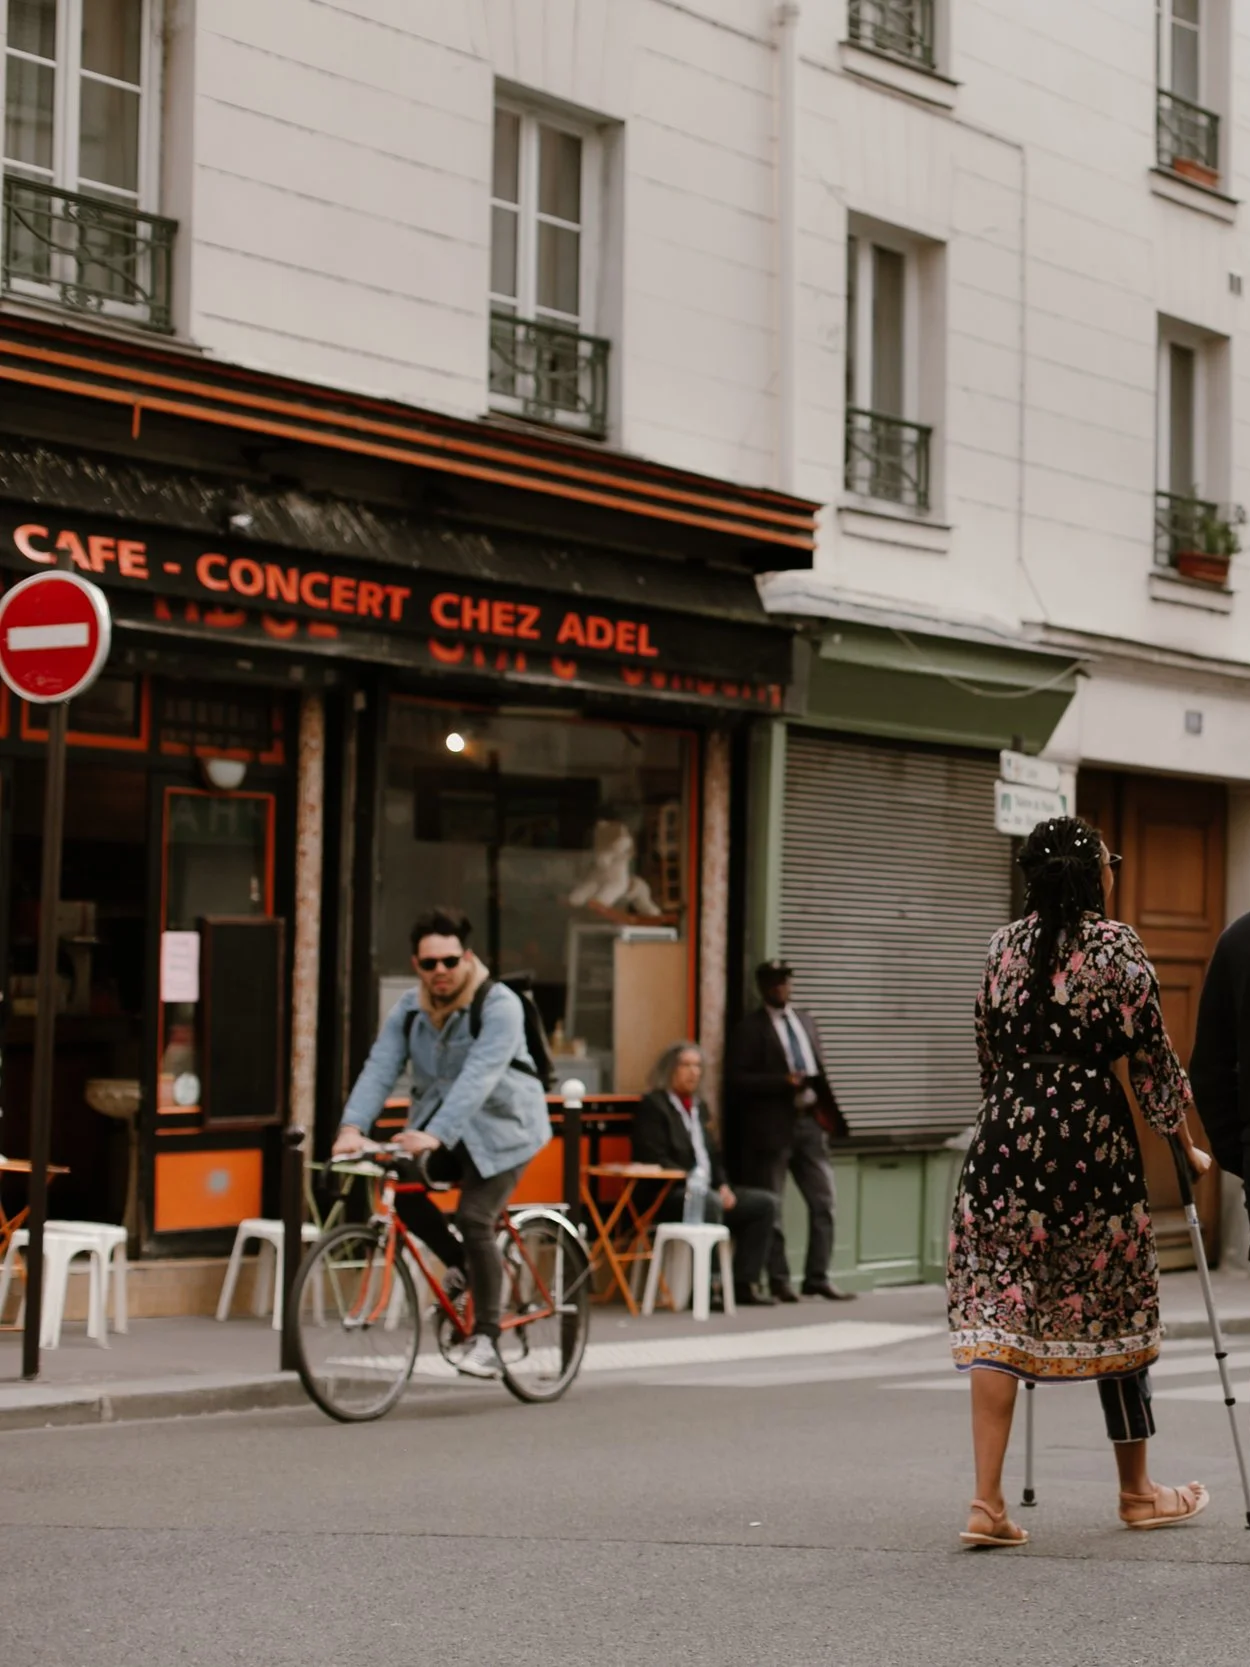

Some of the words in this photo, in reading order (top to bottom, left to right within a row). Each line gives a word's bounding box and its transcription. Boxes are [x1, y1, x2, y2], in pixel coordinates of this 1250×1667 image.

[13, 523, 149, 579] CAFE
[196, 552, 411, 620] CONCERT
[430, 592, 541, 640] CHEZ
[556, 611, 659, 657] ADEL
